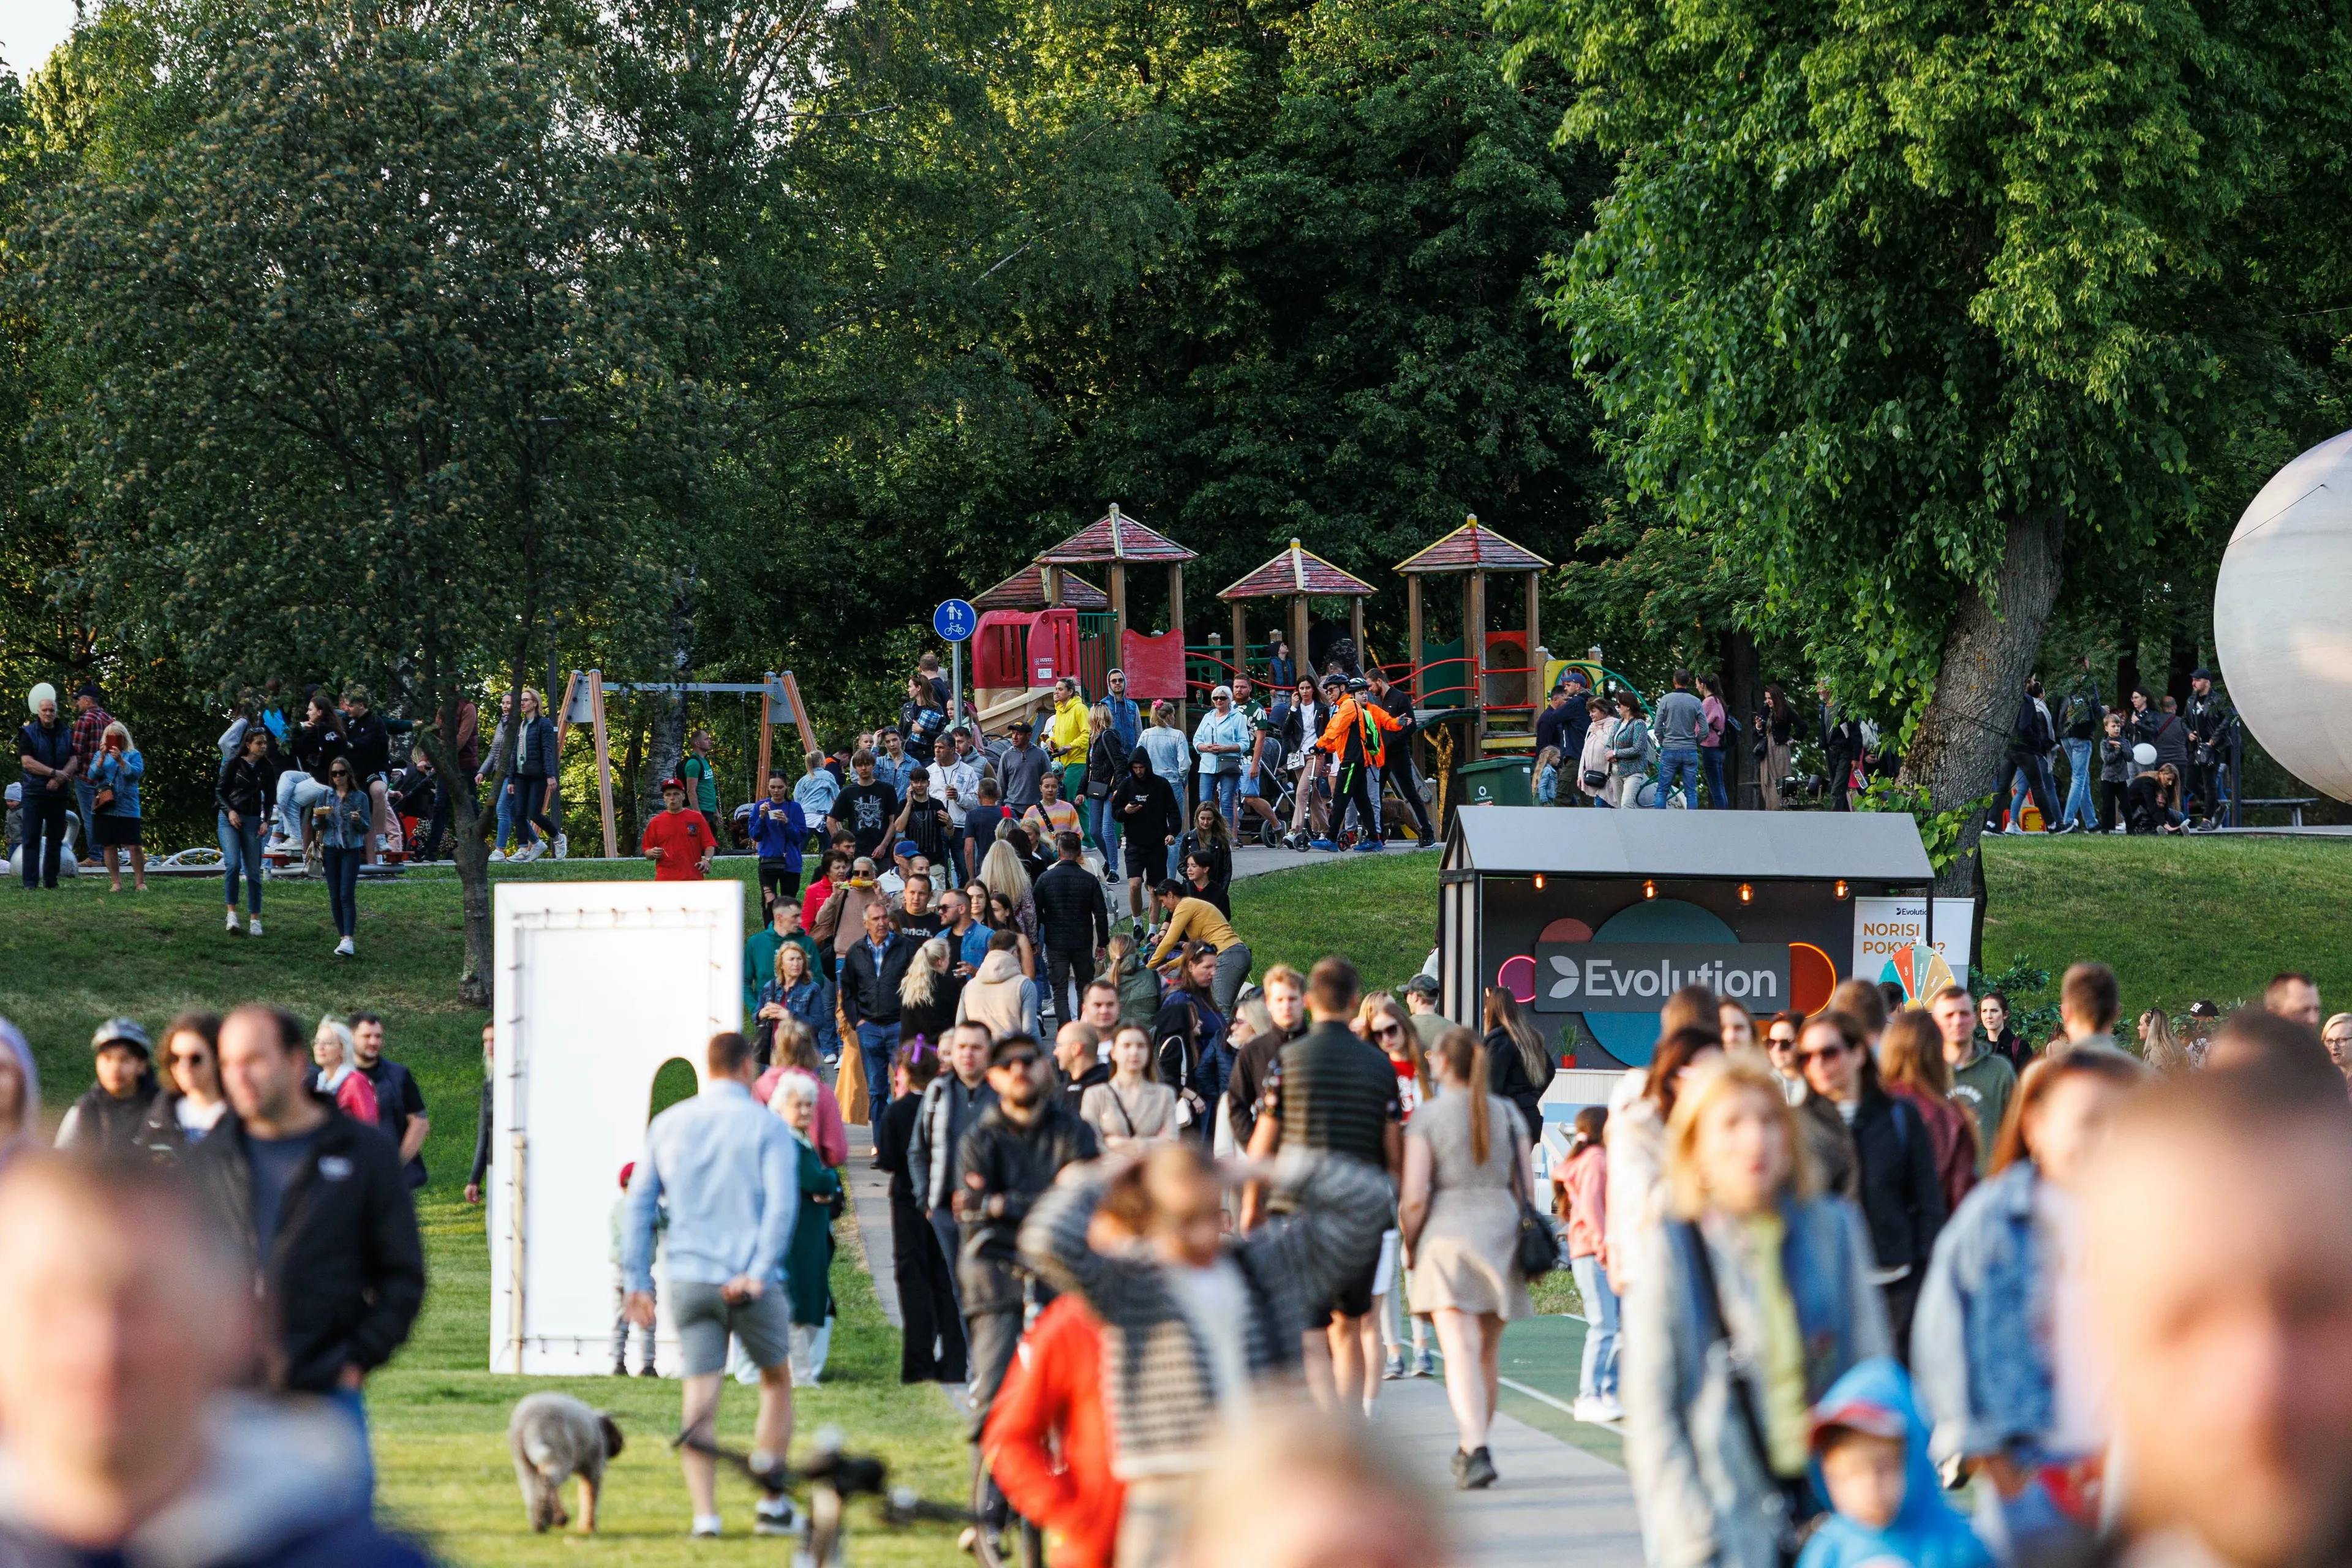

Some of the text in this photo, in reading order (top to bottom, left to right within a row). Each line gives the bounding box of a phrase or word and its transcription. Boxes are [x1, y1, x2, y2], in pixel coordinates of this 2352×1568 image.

[902, 927, 933, 938] ench.
[1863, 923, 1920, 937] NORISI
[1585, 959, 1777, 997] Evolution
